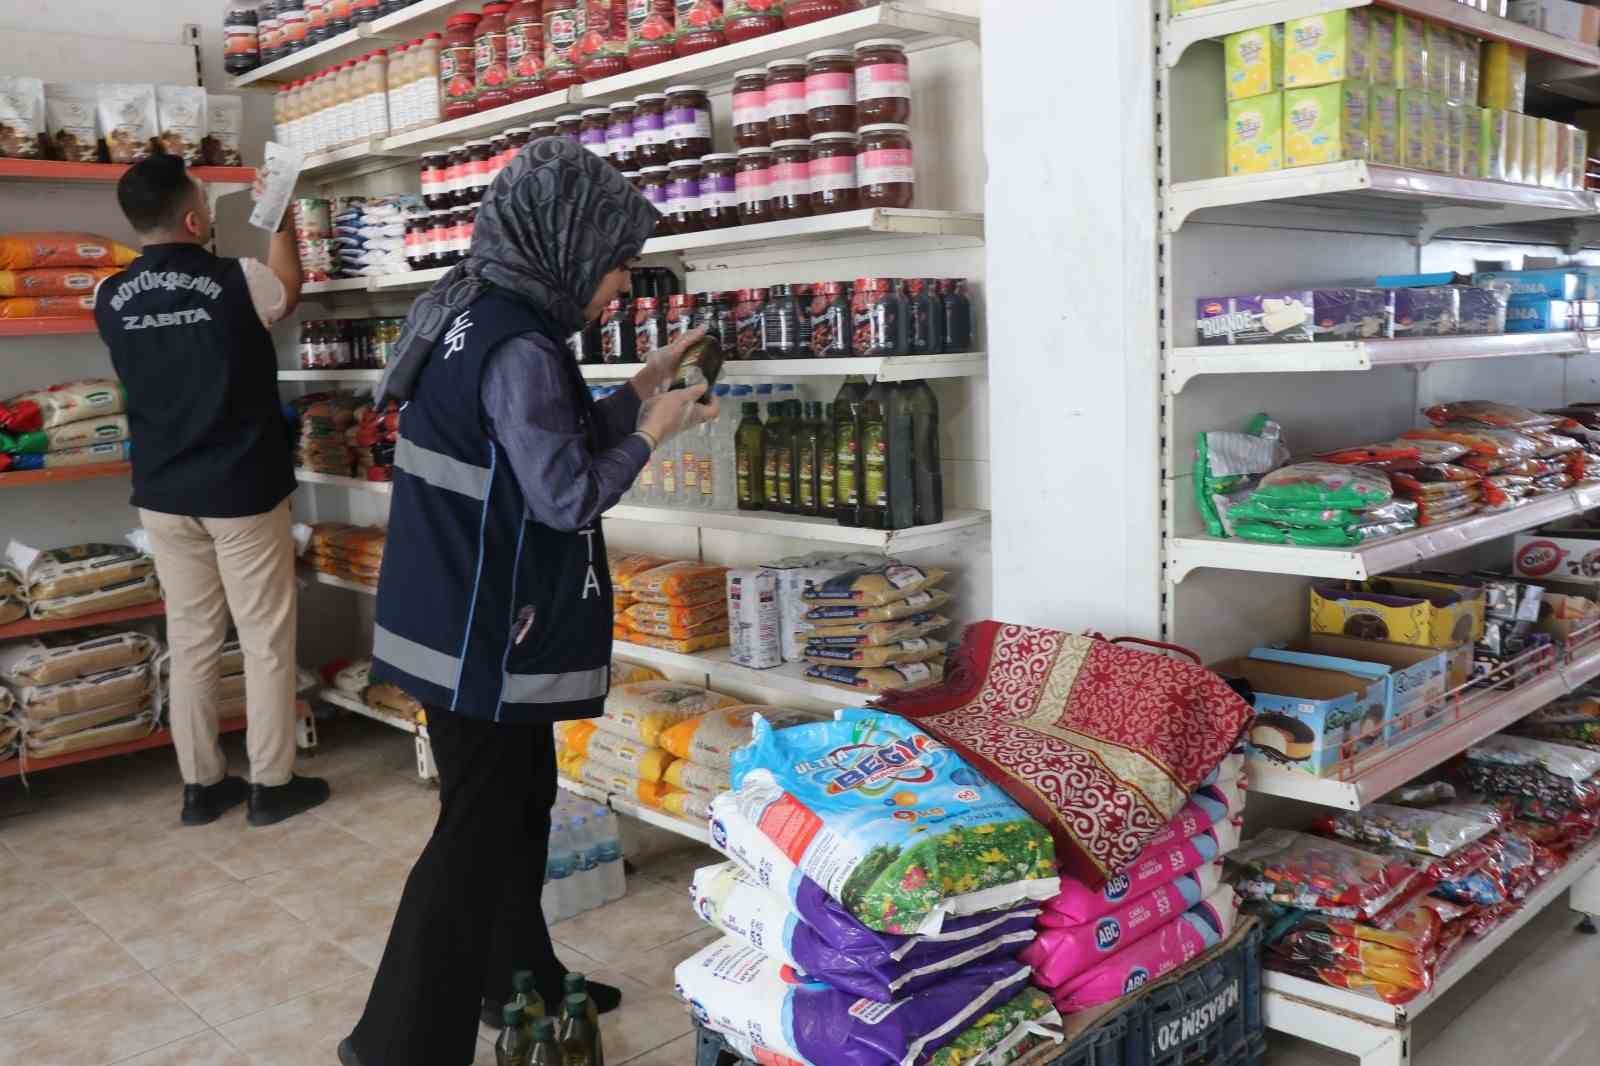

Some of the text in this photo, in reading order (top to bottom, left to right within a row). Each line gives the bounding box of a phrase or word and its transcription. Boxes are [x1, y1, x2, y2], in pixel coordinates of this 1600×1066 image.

[121, 307, 213, 331] ZABITA
[794, 747, 849, 775] ULTRA
[1106, 873, 1128, 896] ABC
[1098, 922, 1120, 946] ABC
